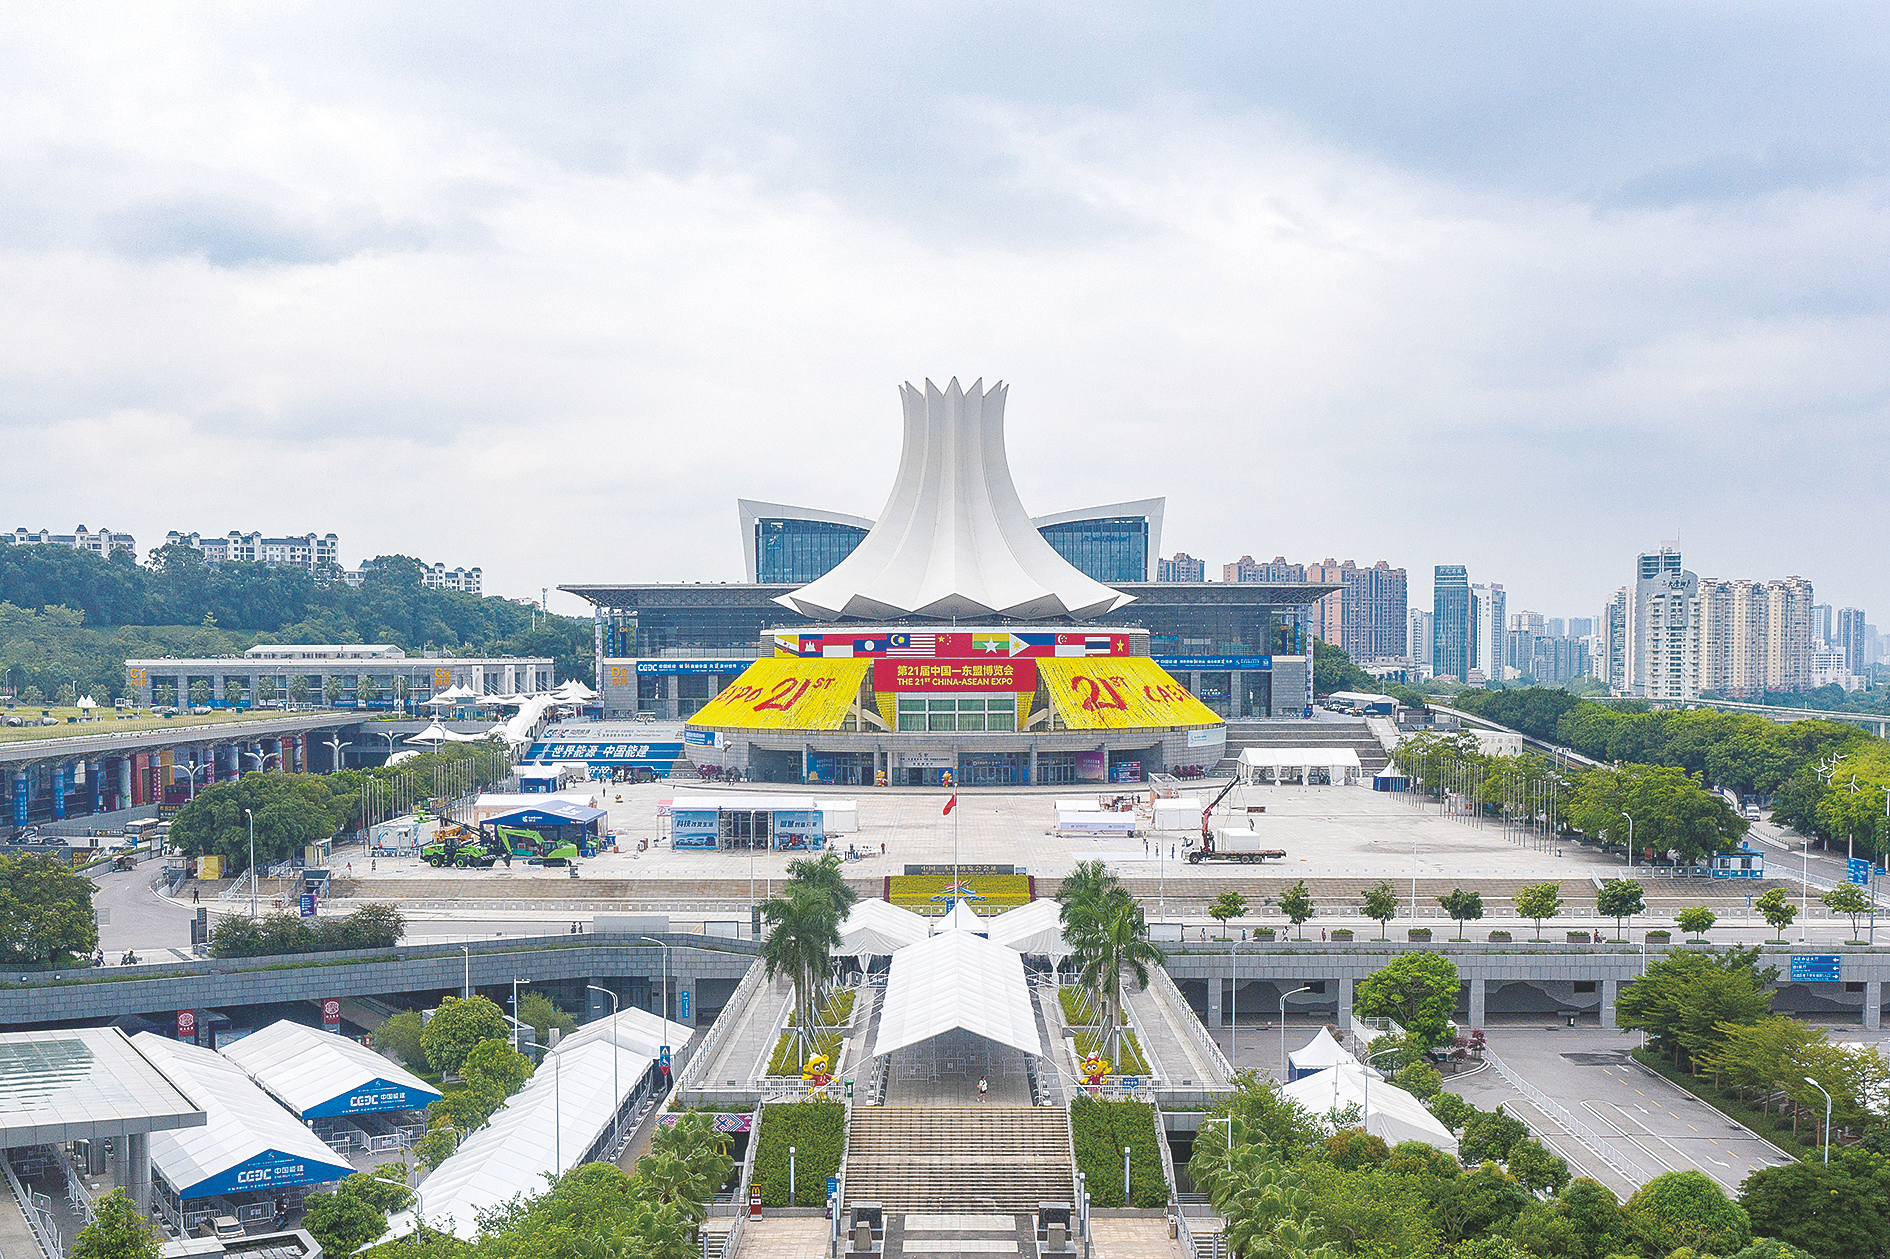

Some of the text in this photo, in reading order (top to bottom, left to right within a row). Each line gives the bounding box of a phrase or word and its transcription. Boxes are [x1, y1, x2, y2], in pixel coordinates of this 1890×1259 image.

[897, 678, 1013, 686] THE 21ST CHINA-ASEAN EXPO
[552, 745, 650, 758] 世界能源 中国能建
